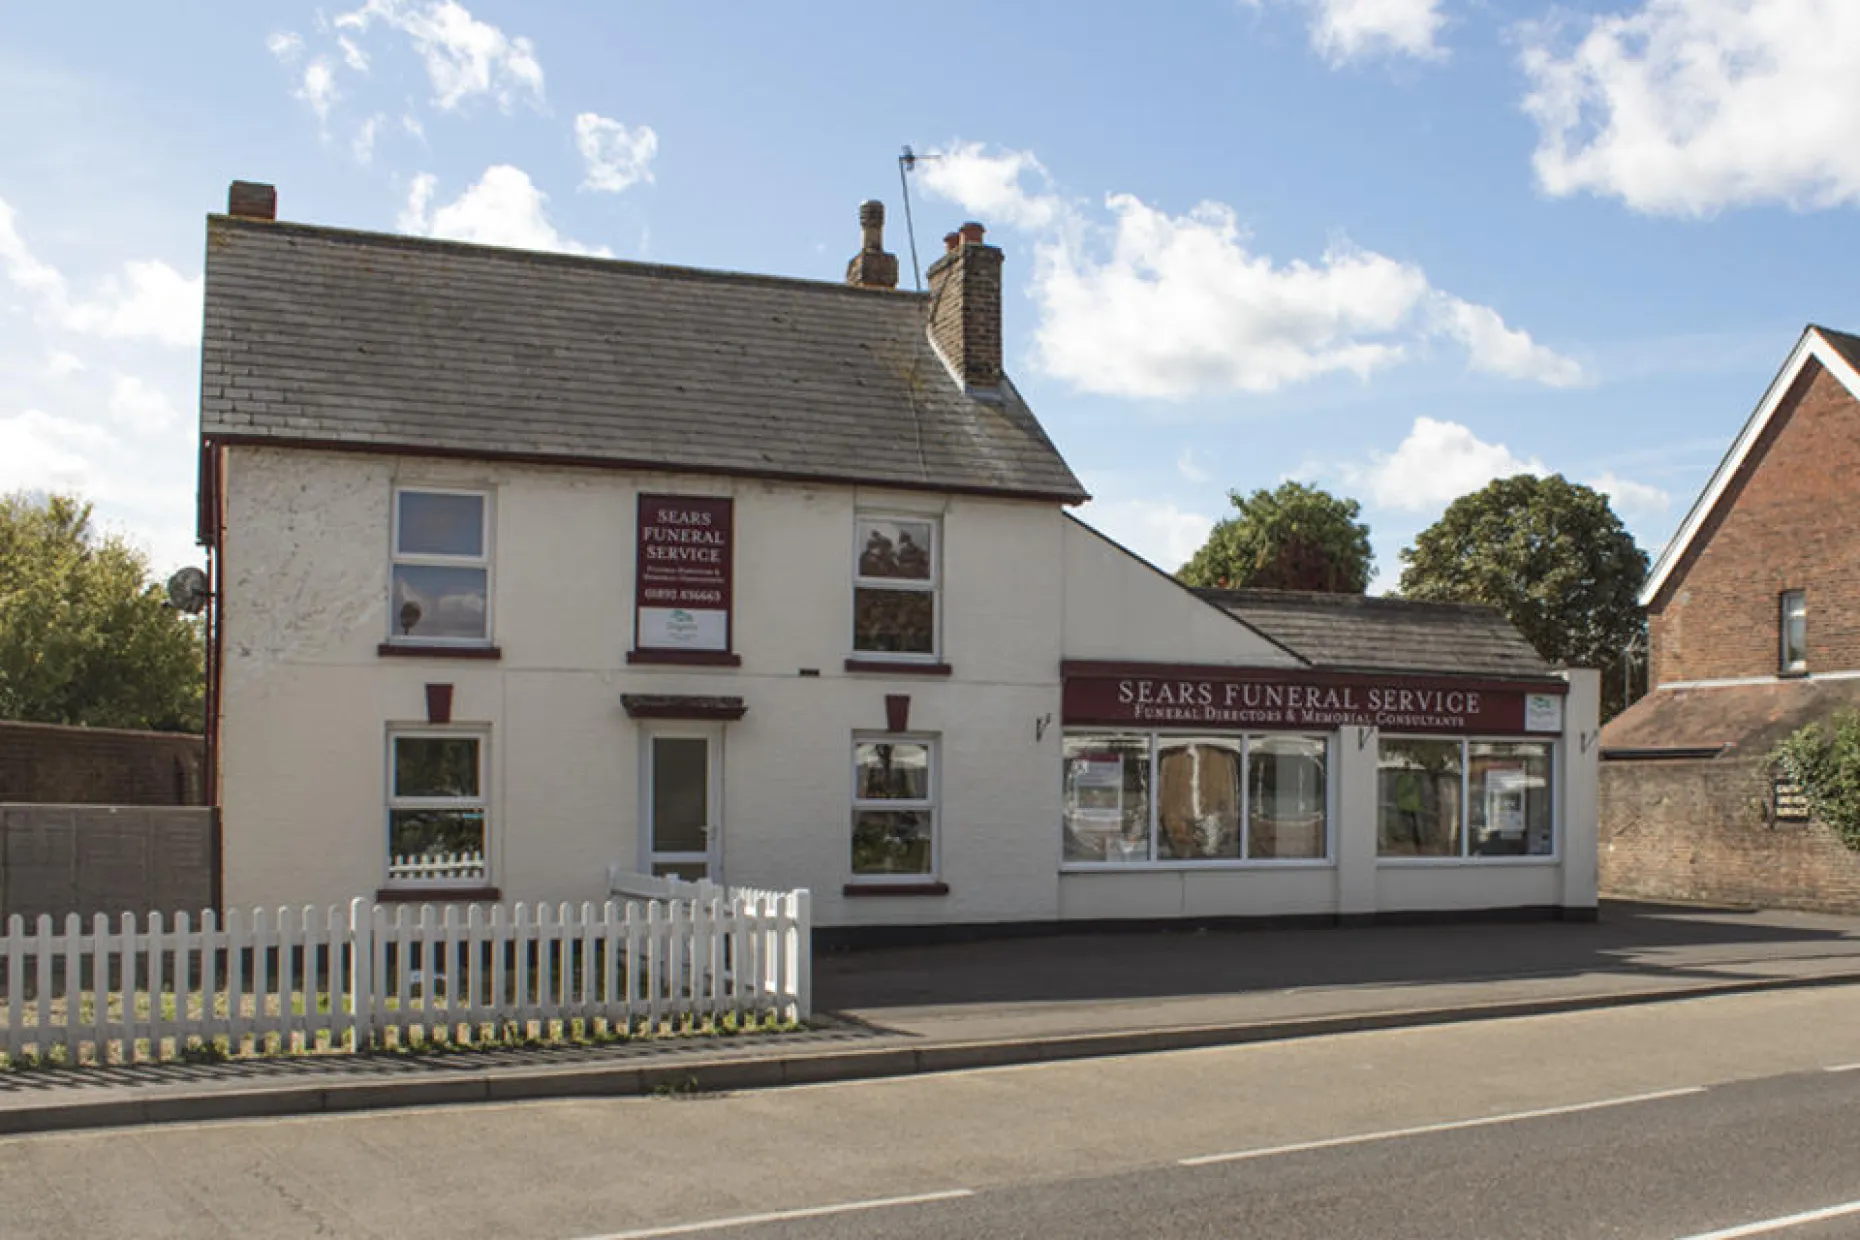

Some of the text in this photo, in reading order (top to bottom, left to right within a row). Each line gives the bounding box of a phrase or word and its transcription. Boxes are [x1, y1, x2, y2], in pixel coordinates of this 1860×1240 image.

[658, 510, 711, 525] SEARS
[644, 527, 724, 543] FUNERAL
[646, 545, 720, 562] SERVICE
[1118, 680, 1480, 713] SEARS FUNERAL SERVICE
